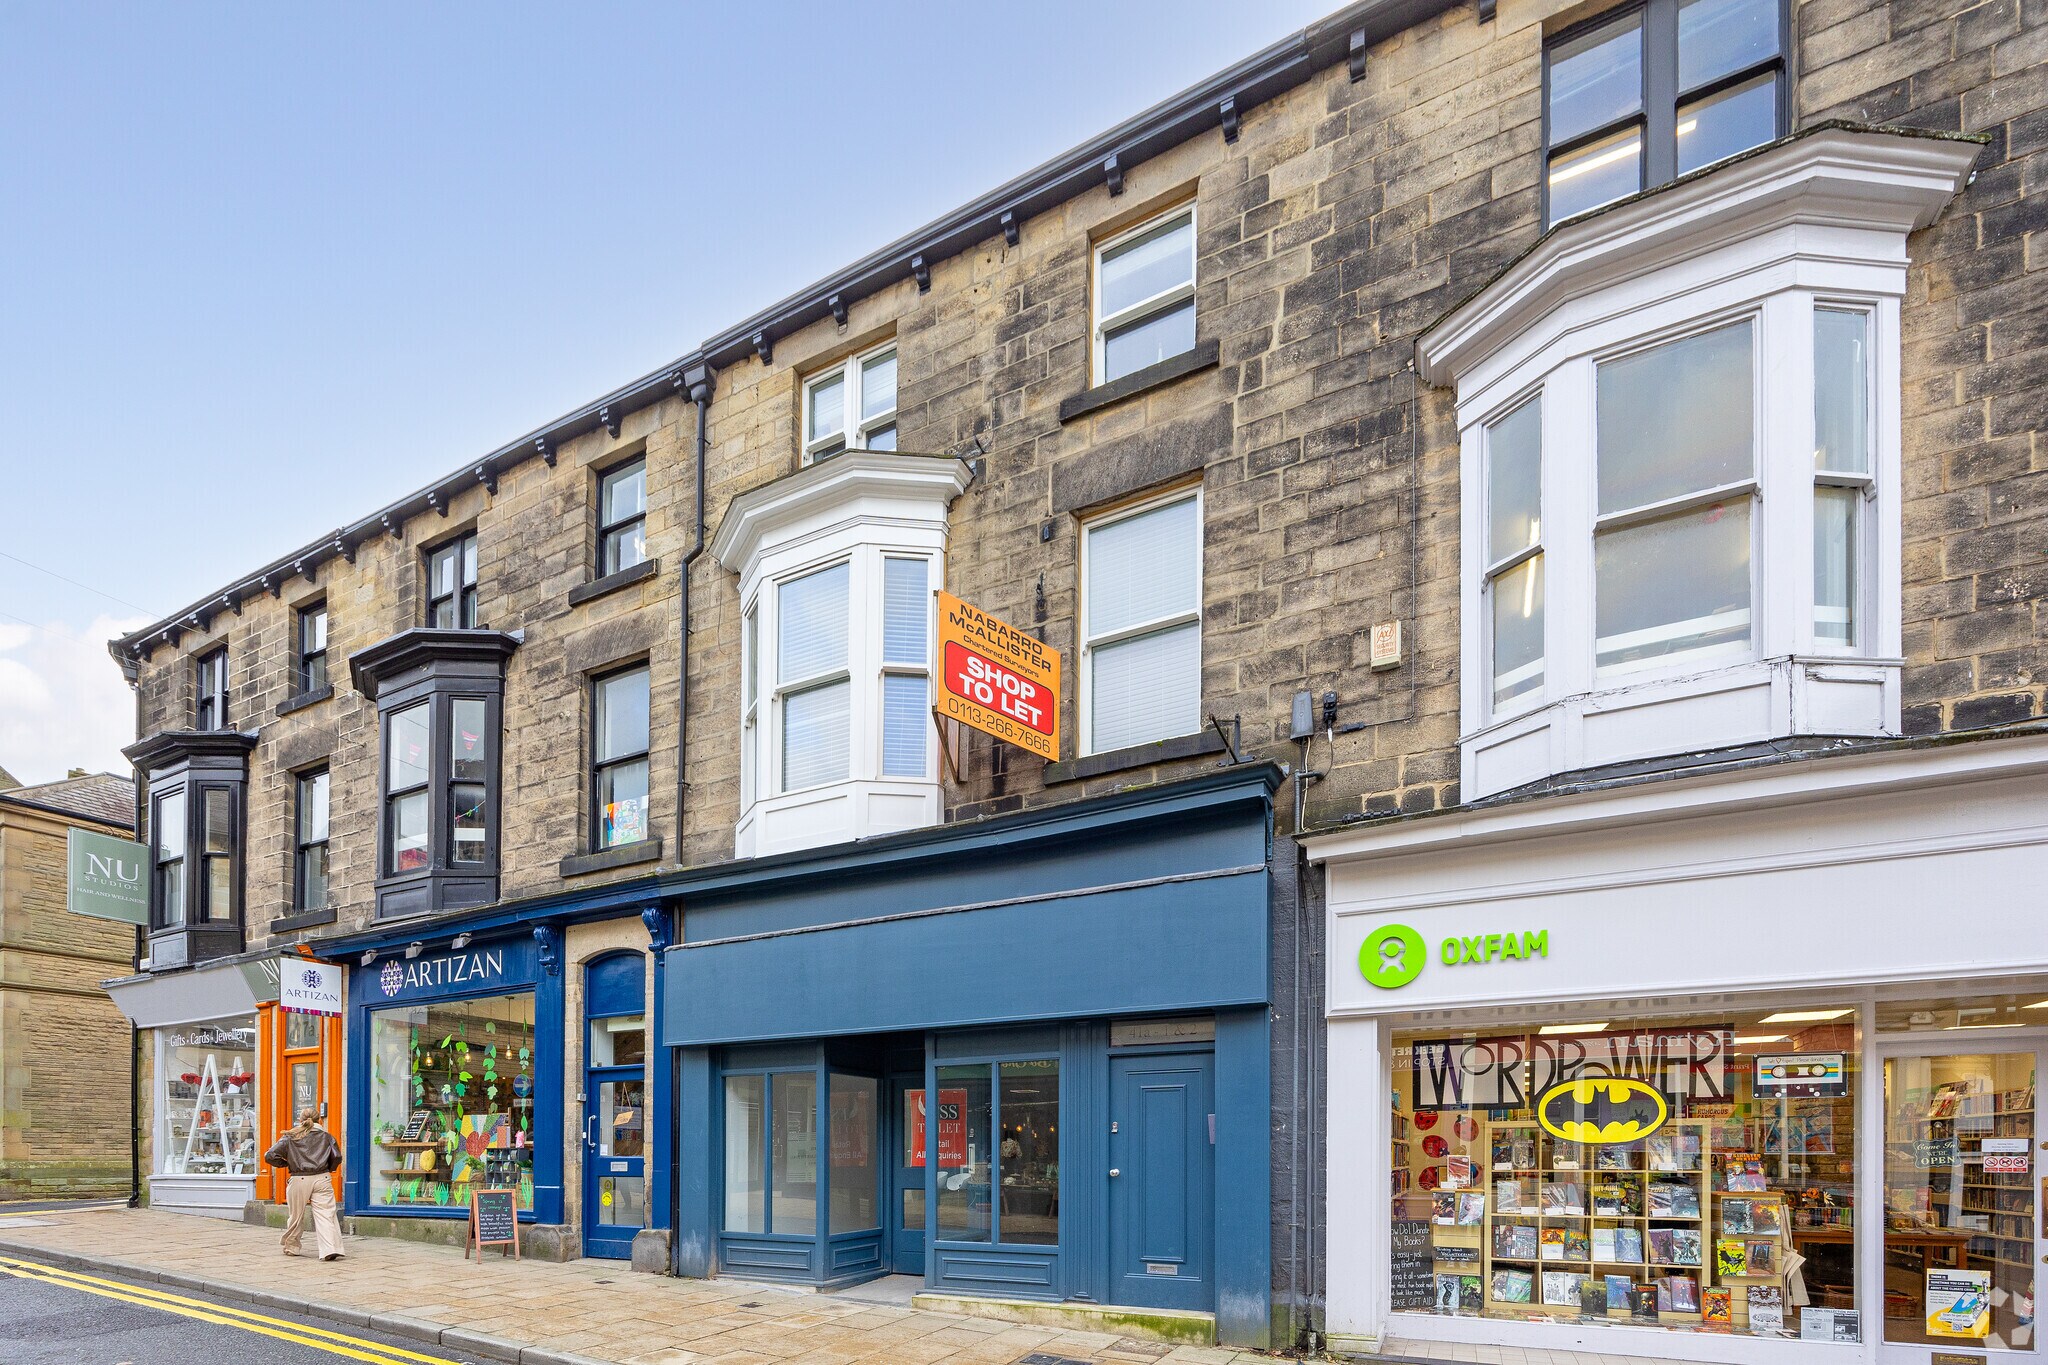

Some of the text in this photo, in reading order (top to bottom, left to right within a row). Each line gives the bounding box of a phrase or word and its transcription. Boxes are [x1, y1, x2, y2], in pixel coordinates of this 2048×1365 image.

[960, 604, 1043, 655] NABARRO
[949, 611, 1052, 673] McALLISTER
[963, 634, 1040, 678] Chartered Surveyors
[967, 655, 1036, 701] SHOP
[959, 672, 1043, 727] TO LET
[948, 697, 1051, 754] 0113-266-7666
[86, 852, 139, 883] NU
[84, 875, 139, 891] STUDIOS
[76, 886, 94, 895] HAIR
[111, 893, 146, 905] WELLNESS
[1441, 929, 1549, 965] OXFAM
[404, 949, 502, 989] ARTIZAN
[285, 988, 339, 1002] ARTIZAN
[170, 1027, 248, 1047] Gifts Cards Jewellery
[1174, 1023, 1186, 1036] &
[1189, 1023, 1198, 1035] 2
[299, 1085, 312, 1098] NU
[938, 1140, 950, 1148] tail
[1942, 1141, 1956, 1149] In
[938, 1151, 962, 1160] quiries
[1920, 1155, 1956, 1165] OPEN
[1391, 1227, 1399, 1235] ow
[1399, 1223, 1409, 1235] Do
[1413, 1222, 1430, 1235] Donate
[1393, 1236, 1426, 1249] My Books?
[1391, 1262, 1401, 1273] ring
[1391, 1273, 1403, 1284] ring
[1391, 1296, 1434, 1307] EASE GIFT AID
